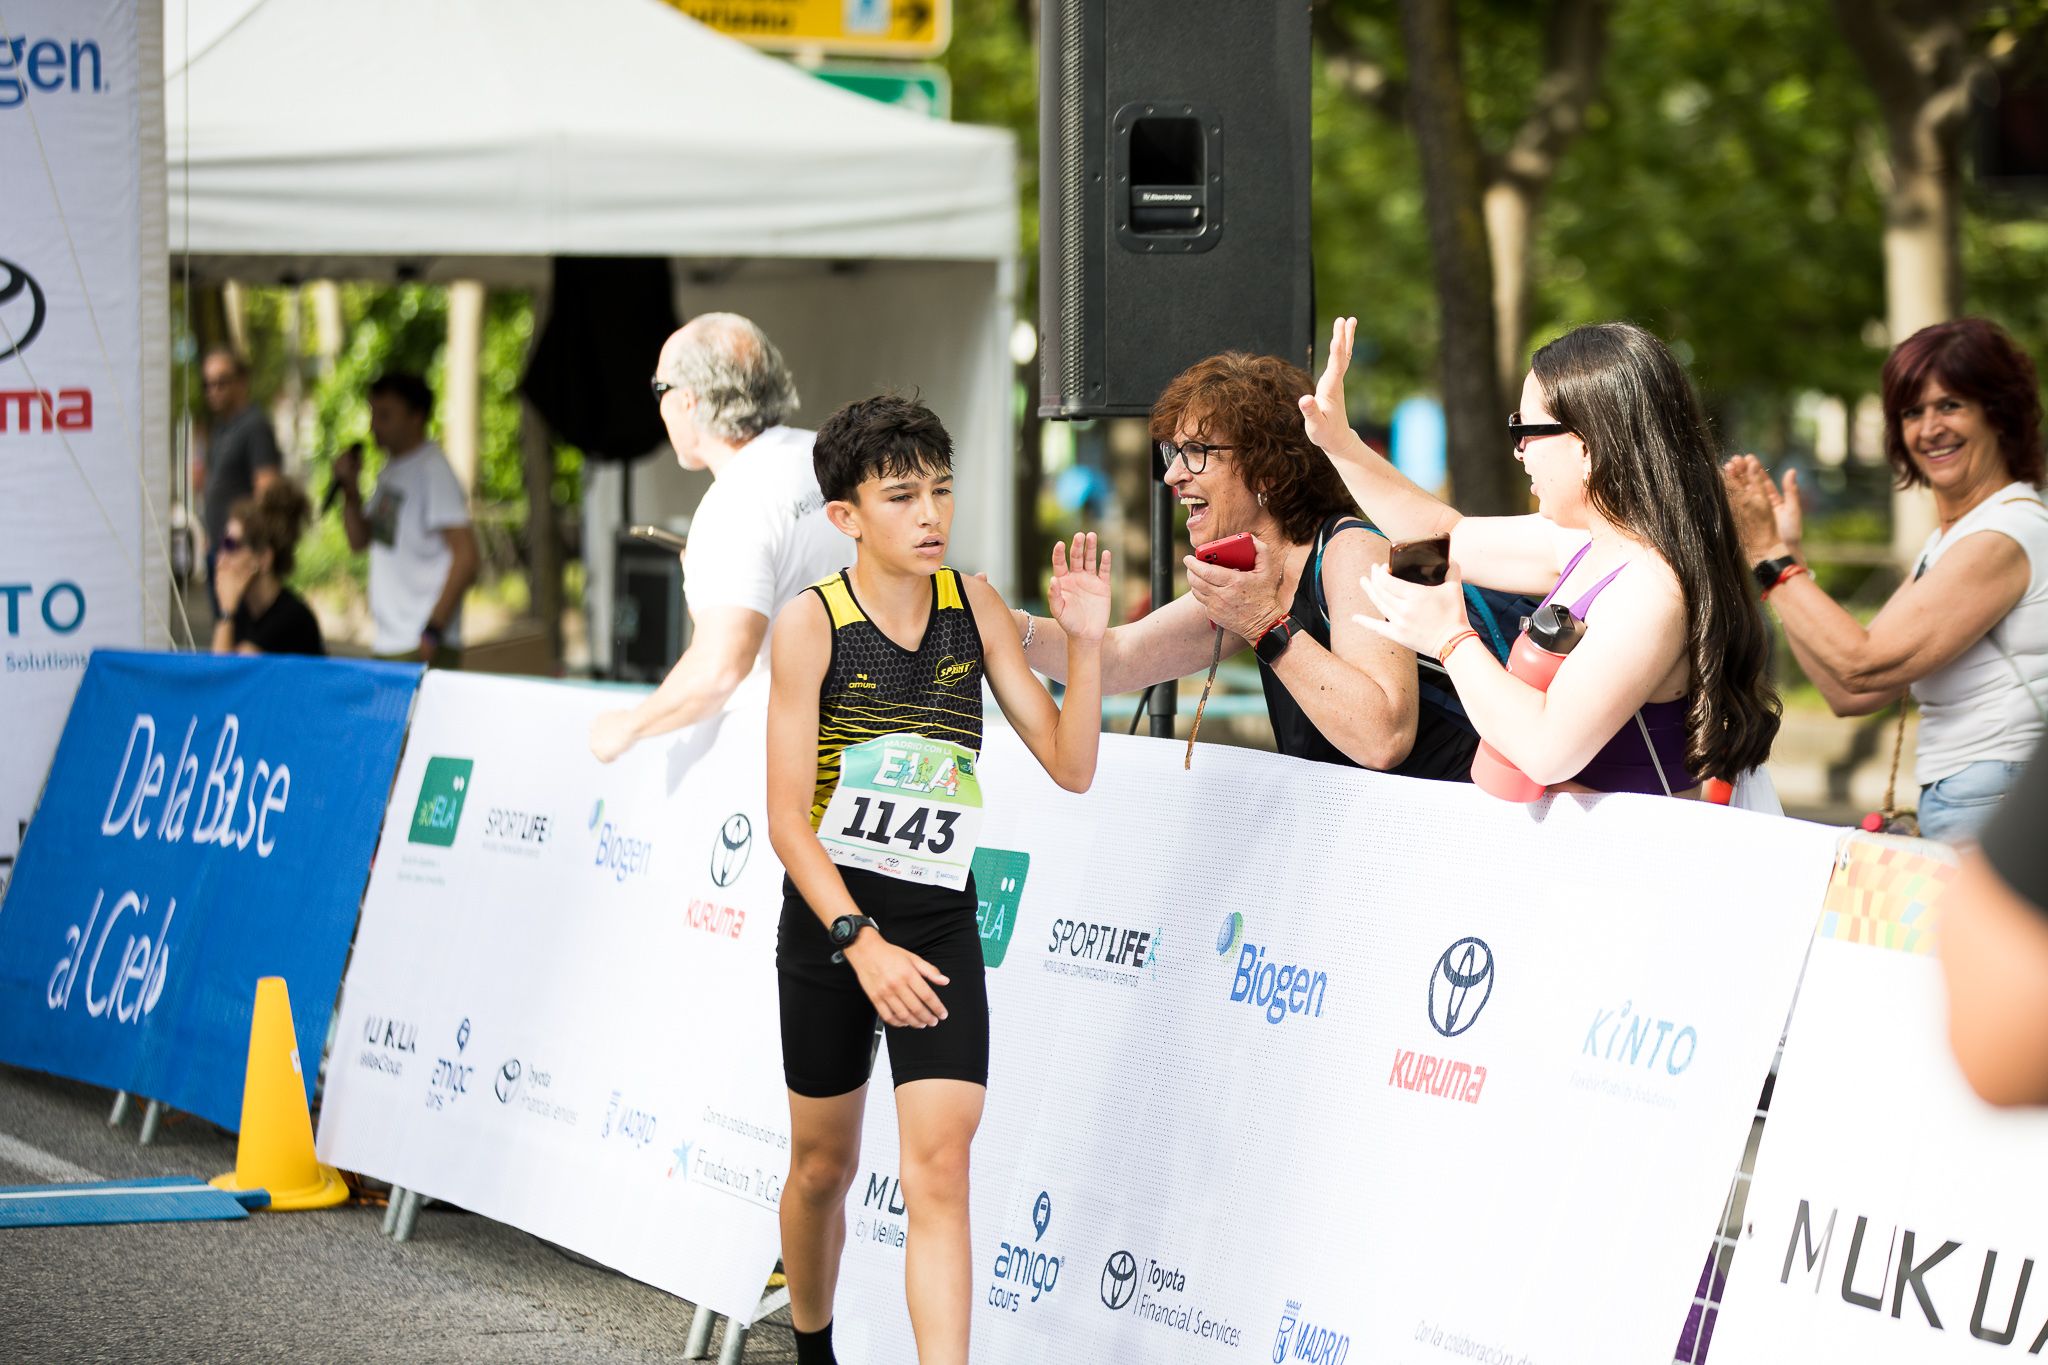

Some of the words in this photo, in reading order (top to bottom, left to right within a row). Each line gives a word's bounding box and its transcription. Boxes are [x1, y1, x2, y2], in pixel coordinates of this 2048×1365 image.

[848, 681, 877, 689] amura
[872, 748, 959, 797] ELA
[884, 740, 922, 751] MADRID
[102, 713, 165, 840] De
[157, 714, 199, 843] la
[192, 713, 291, 858] Base
[594, 822, 652, 883] Biogen
[841, 796, 962, 855] 1143
[46, 888, 104, 1011] al
[85, 890, 176, 1025] Cielo
[1048, 918, 1151, 968] SPORTLIFE
[1230, 943, 1328, 1025] Biogen
[988, 1284, 1020, 1313] tours
[994, 1241, 1060, 1303] amigo
[1147, 1258, 1187, 1294] Toyota
[1139, 1293, 1192, 1333] Financial
[1192, 1310, 1242, 1349] Services
